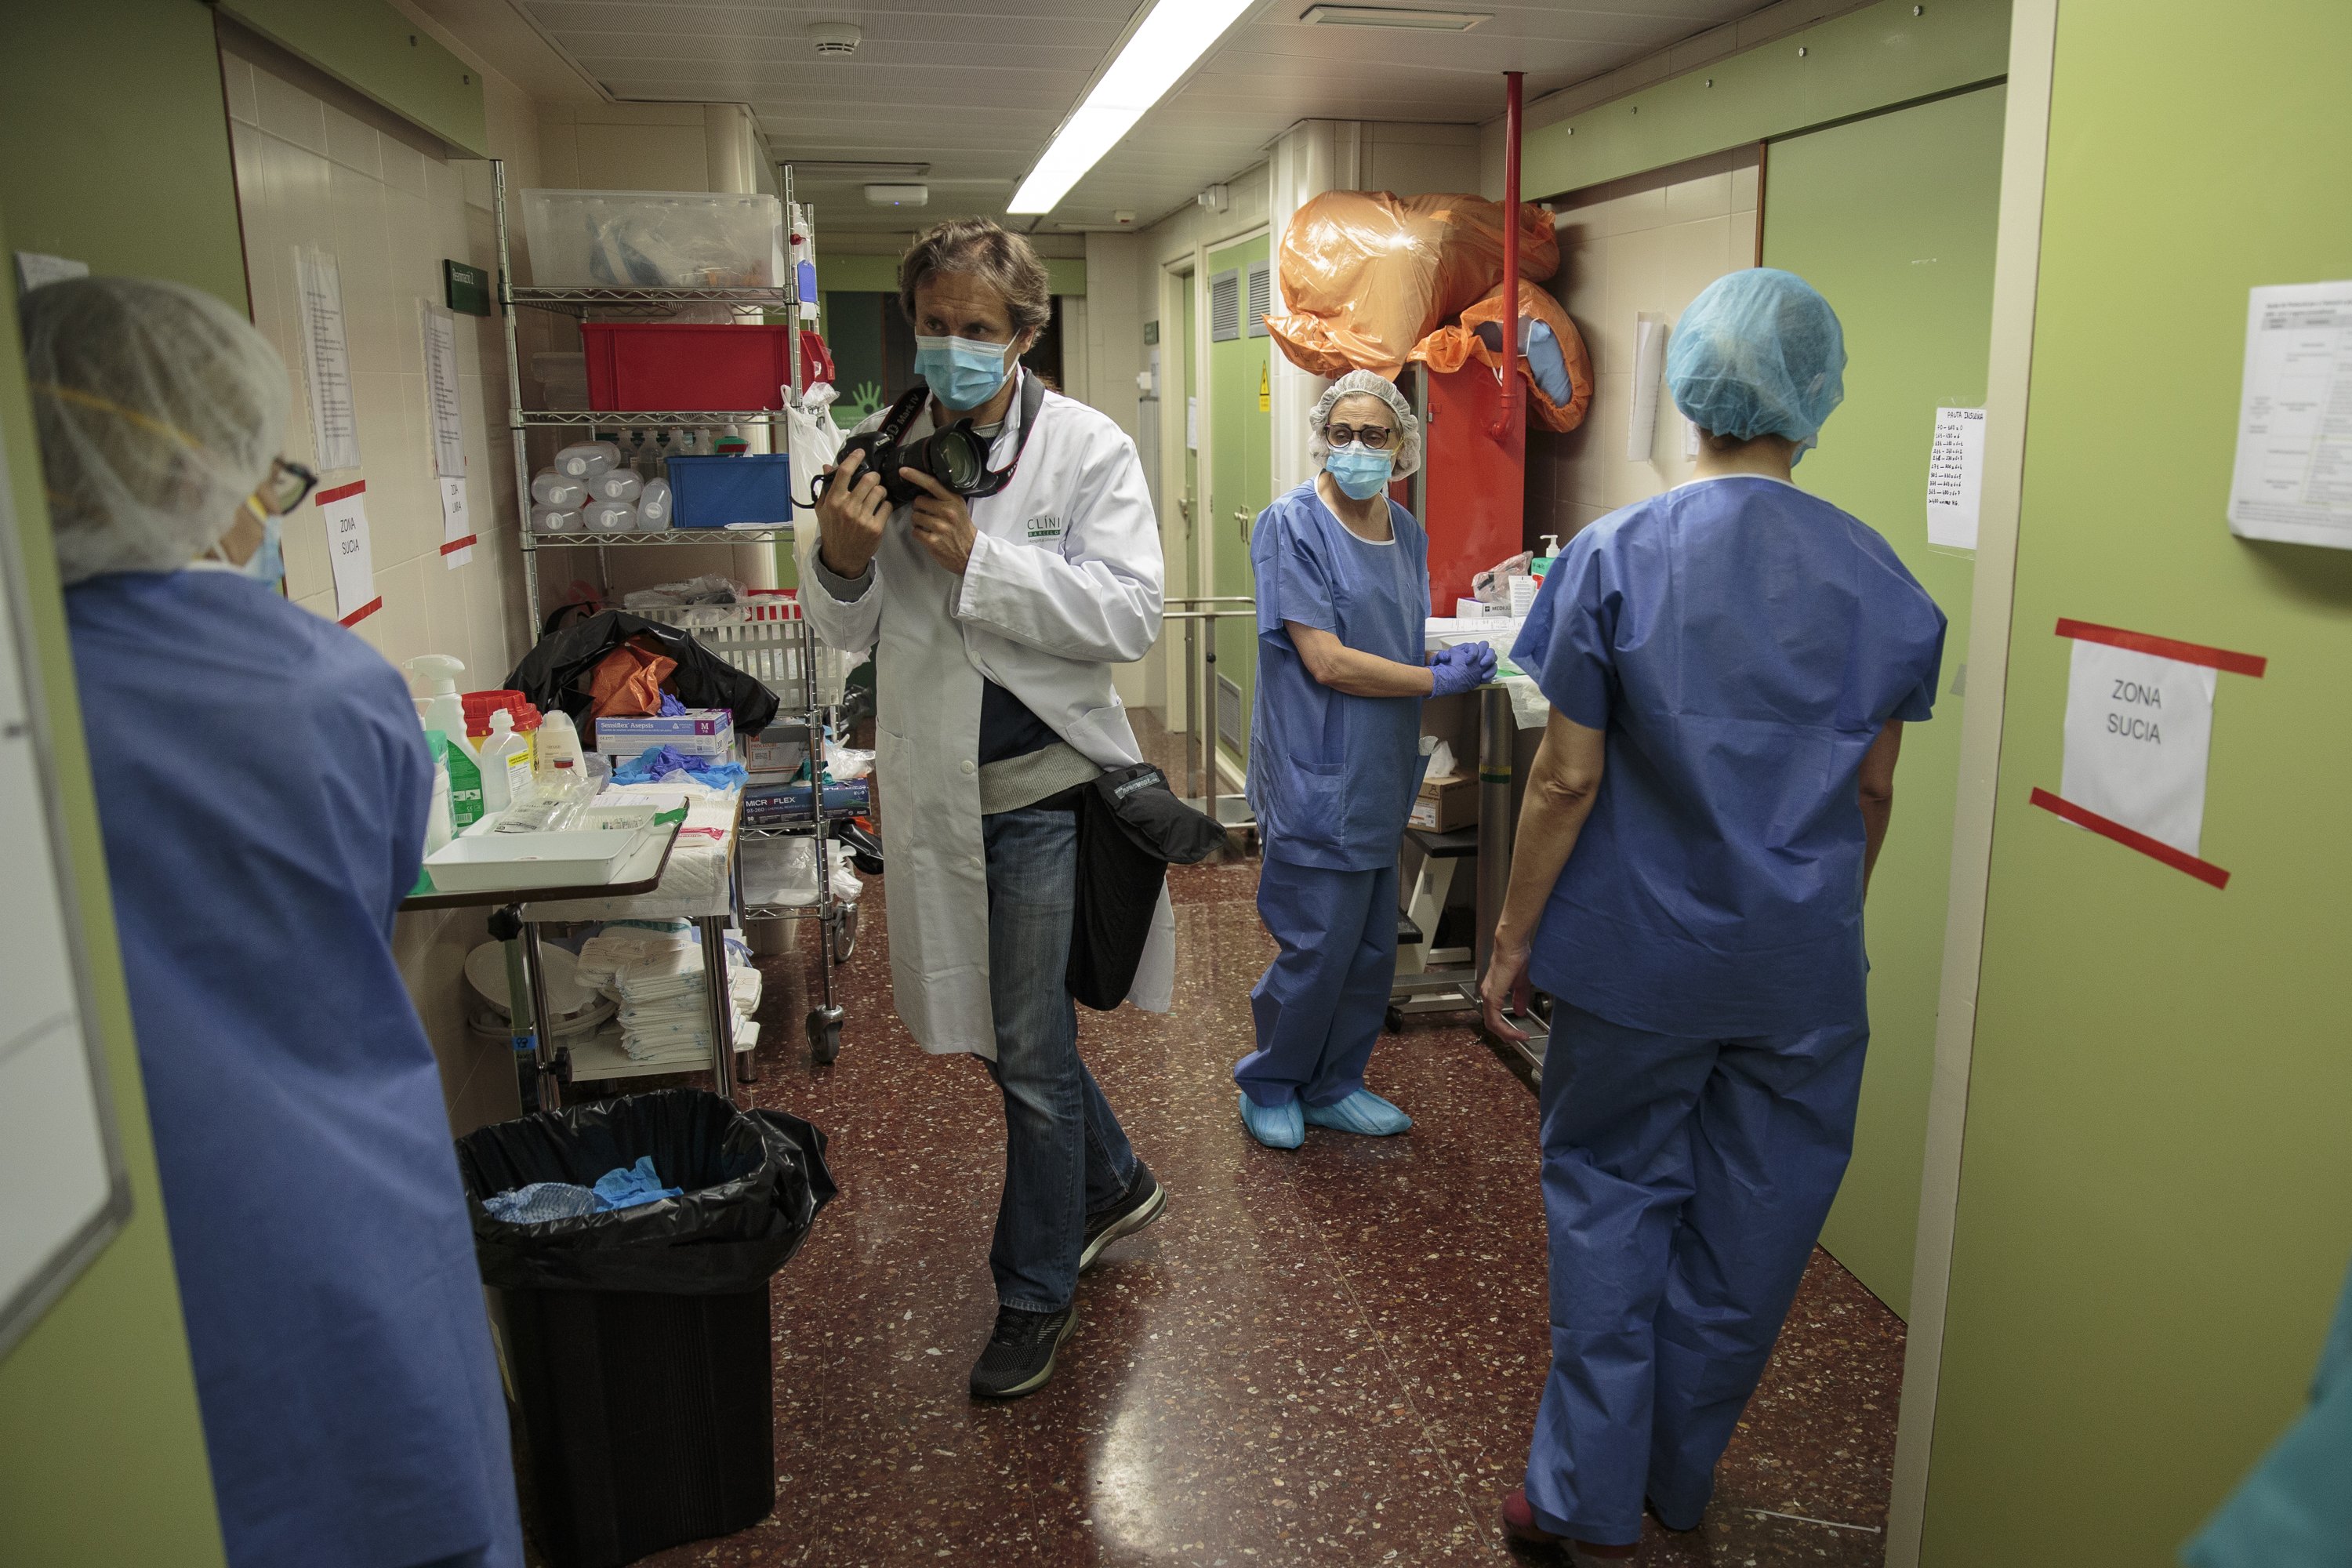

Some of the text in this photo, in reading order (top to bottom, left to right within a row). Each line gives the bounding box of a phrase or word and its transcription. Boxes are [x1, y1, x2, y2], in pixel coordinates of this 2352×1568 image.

[897, 404, 915, 424] Mark
[910, 394, 920, 405] IV
[340, 517, 356, 533] ZONA
[341, 539, 360, 555] SUCIA
[2112, 679, 2161, 709] ZONA
[2107, 713, 2161, 745] SUCIA
